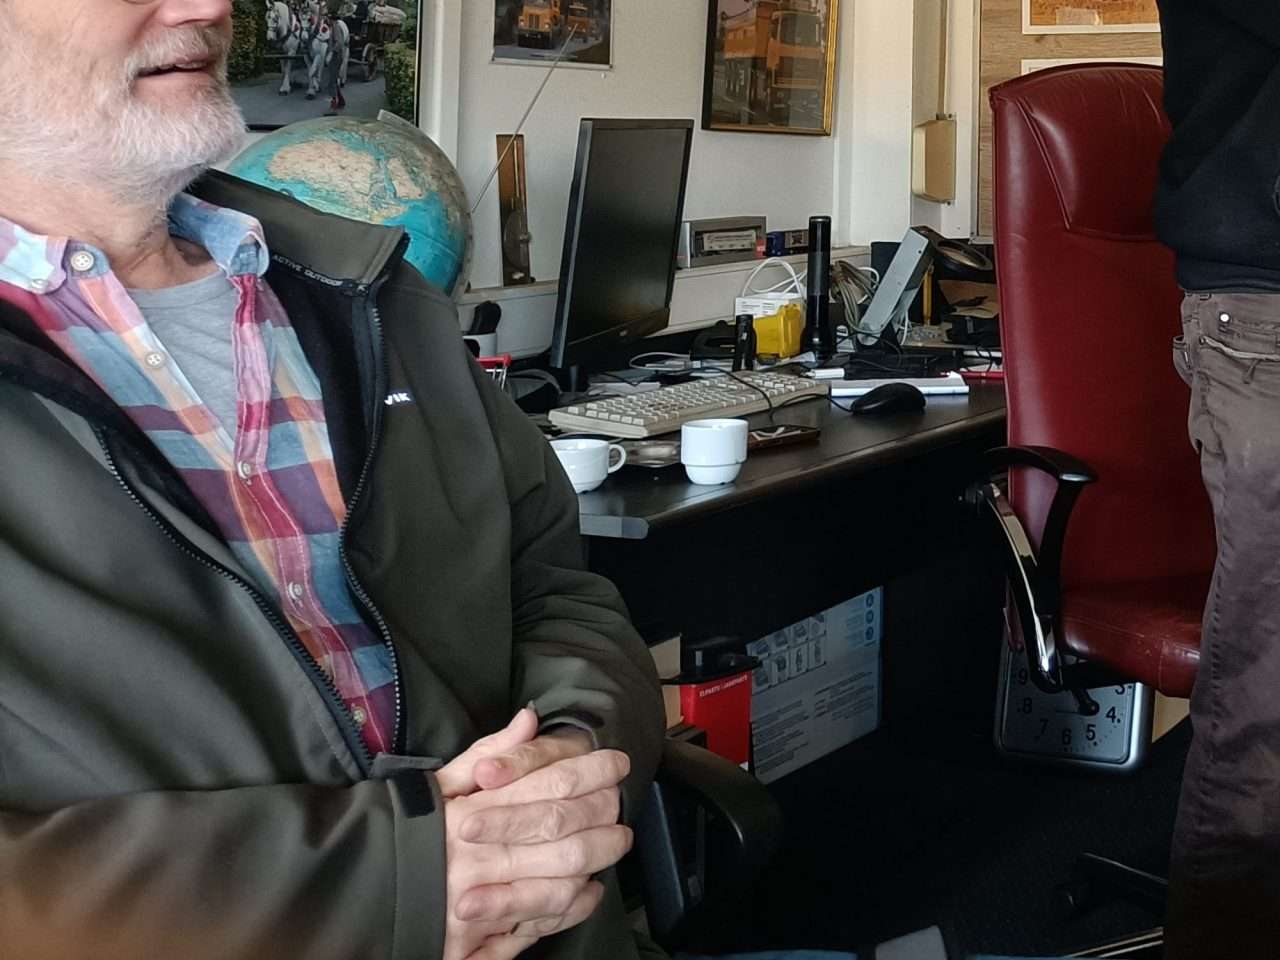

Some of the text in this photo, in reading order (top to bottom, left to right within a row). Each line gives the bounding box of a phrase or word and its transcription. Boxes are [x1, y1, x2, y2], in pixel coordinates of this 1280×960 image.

[272, 254, 301, 272] ACTIVE
[1105, 706, 1117, 723] 4
[1061, 728, 1072, 745] 6
[1085, 724, 1097, 741] 5
